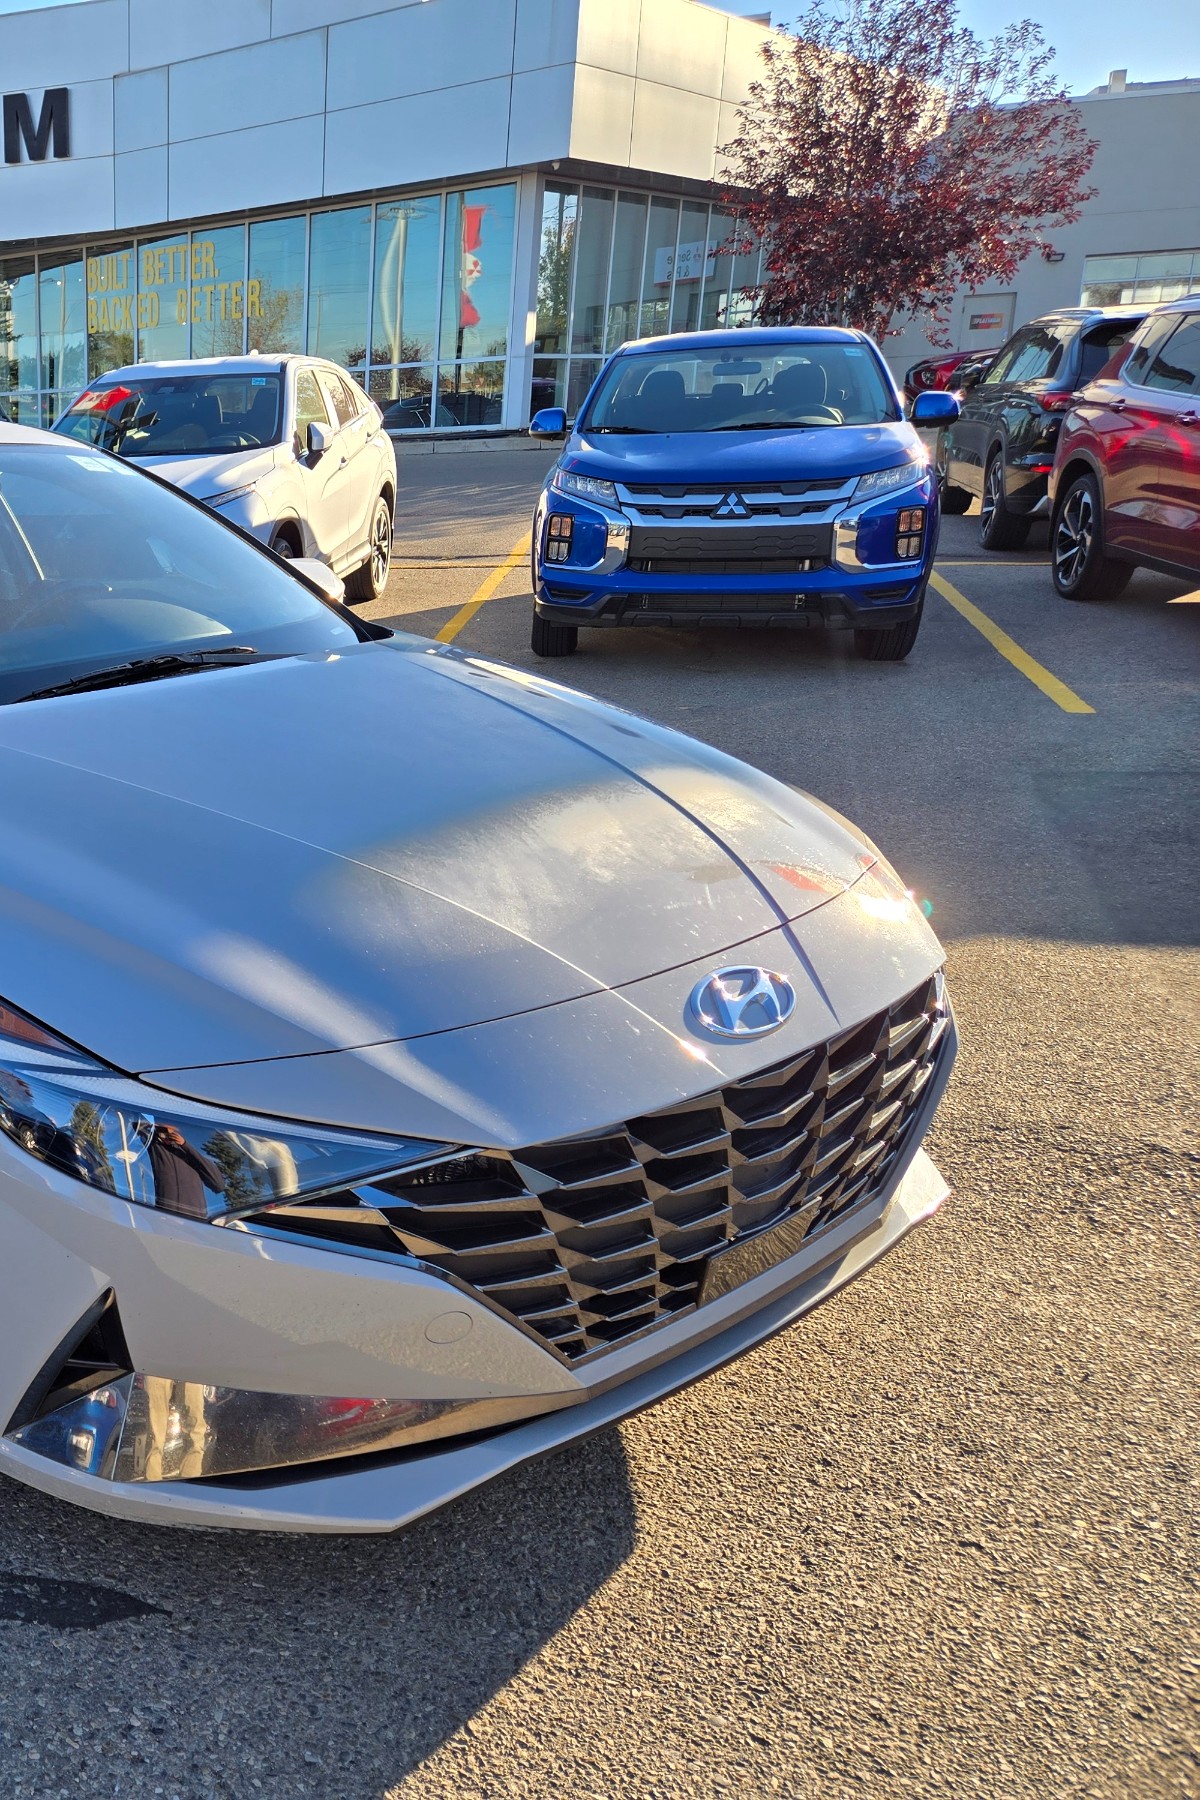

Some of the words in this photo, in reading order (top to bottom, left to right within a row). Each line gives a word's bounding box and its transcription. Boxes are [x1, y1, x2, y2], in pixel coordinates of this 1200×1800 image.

[87, 253, 131, 294] BUILT
[142, 241, 220, 287] BETTER.
[87, 290, 159, 334] BACKED
[176, 279, 265, 325] BETTER.
